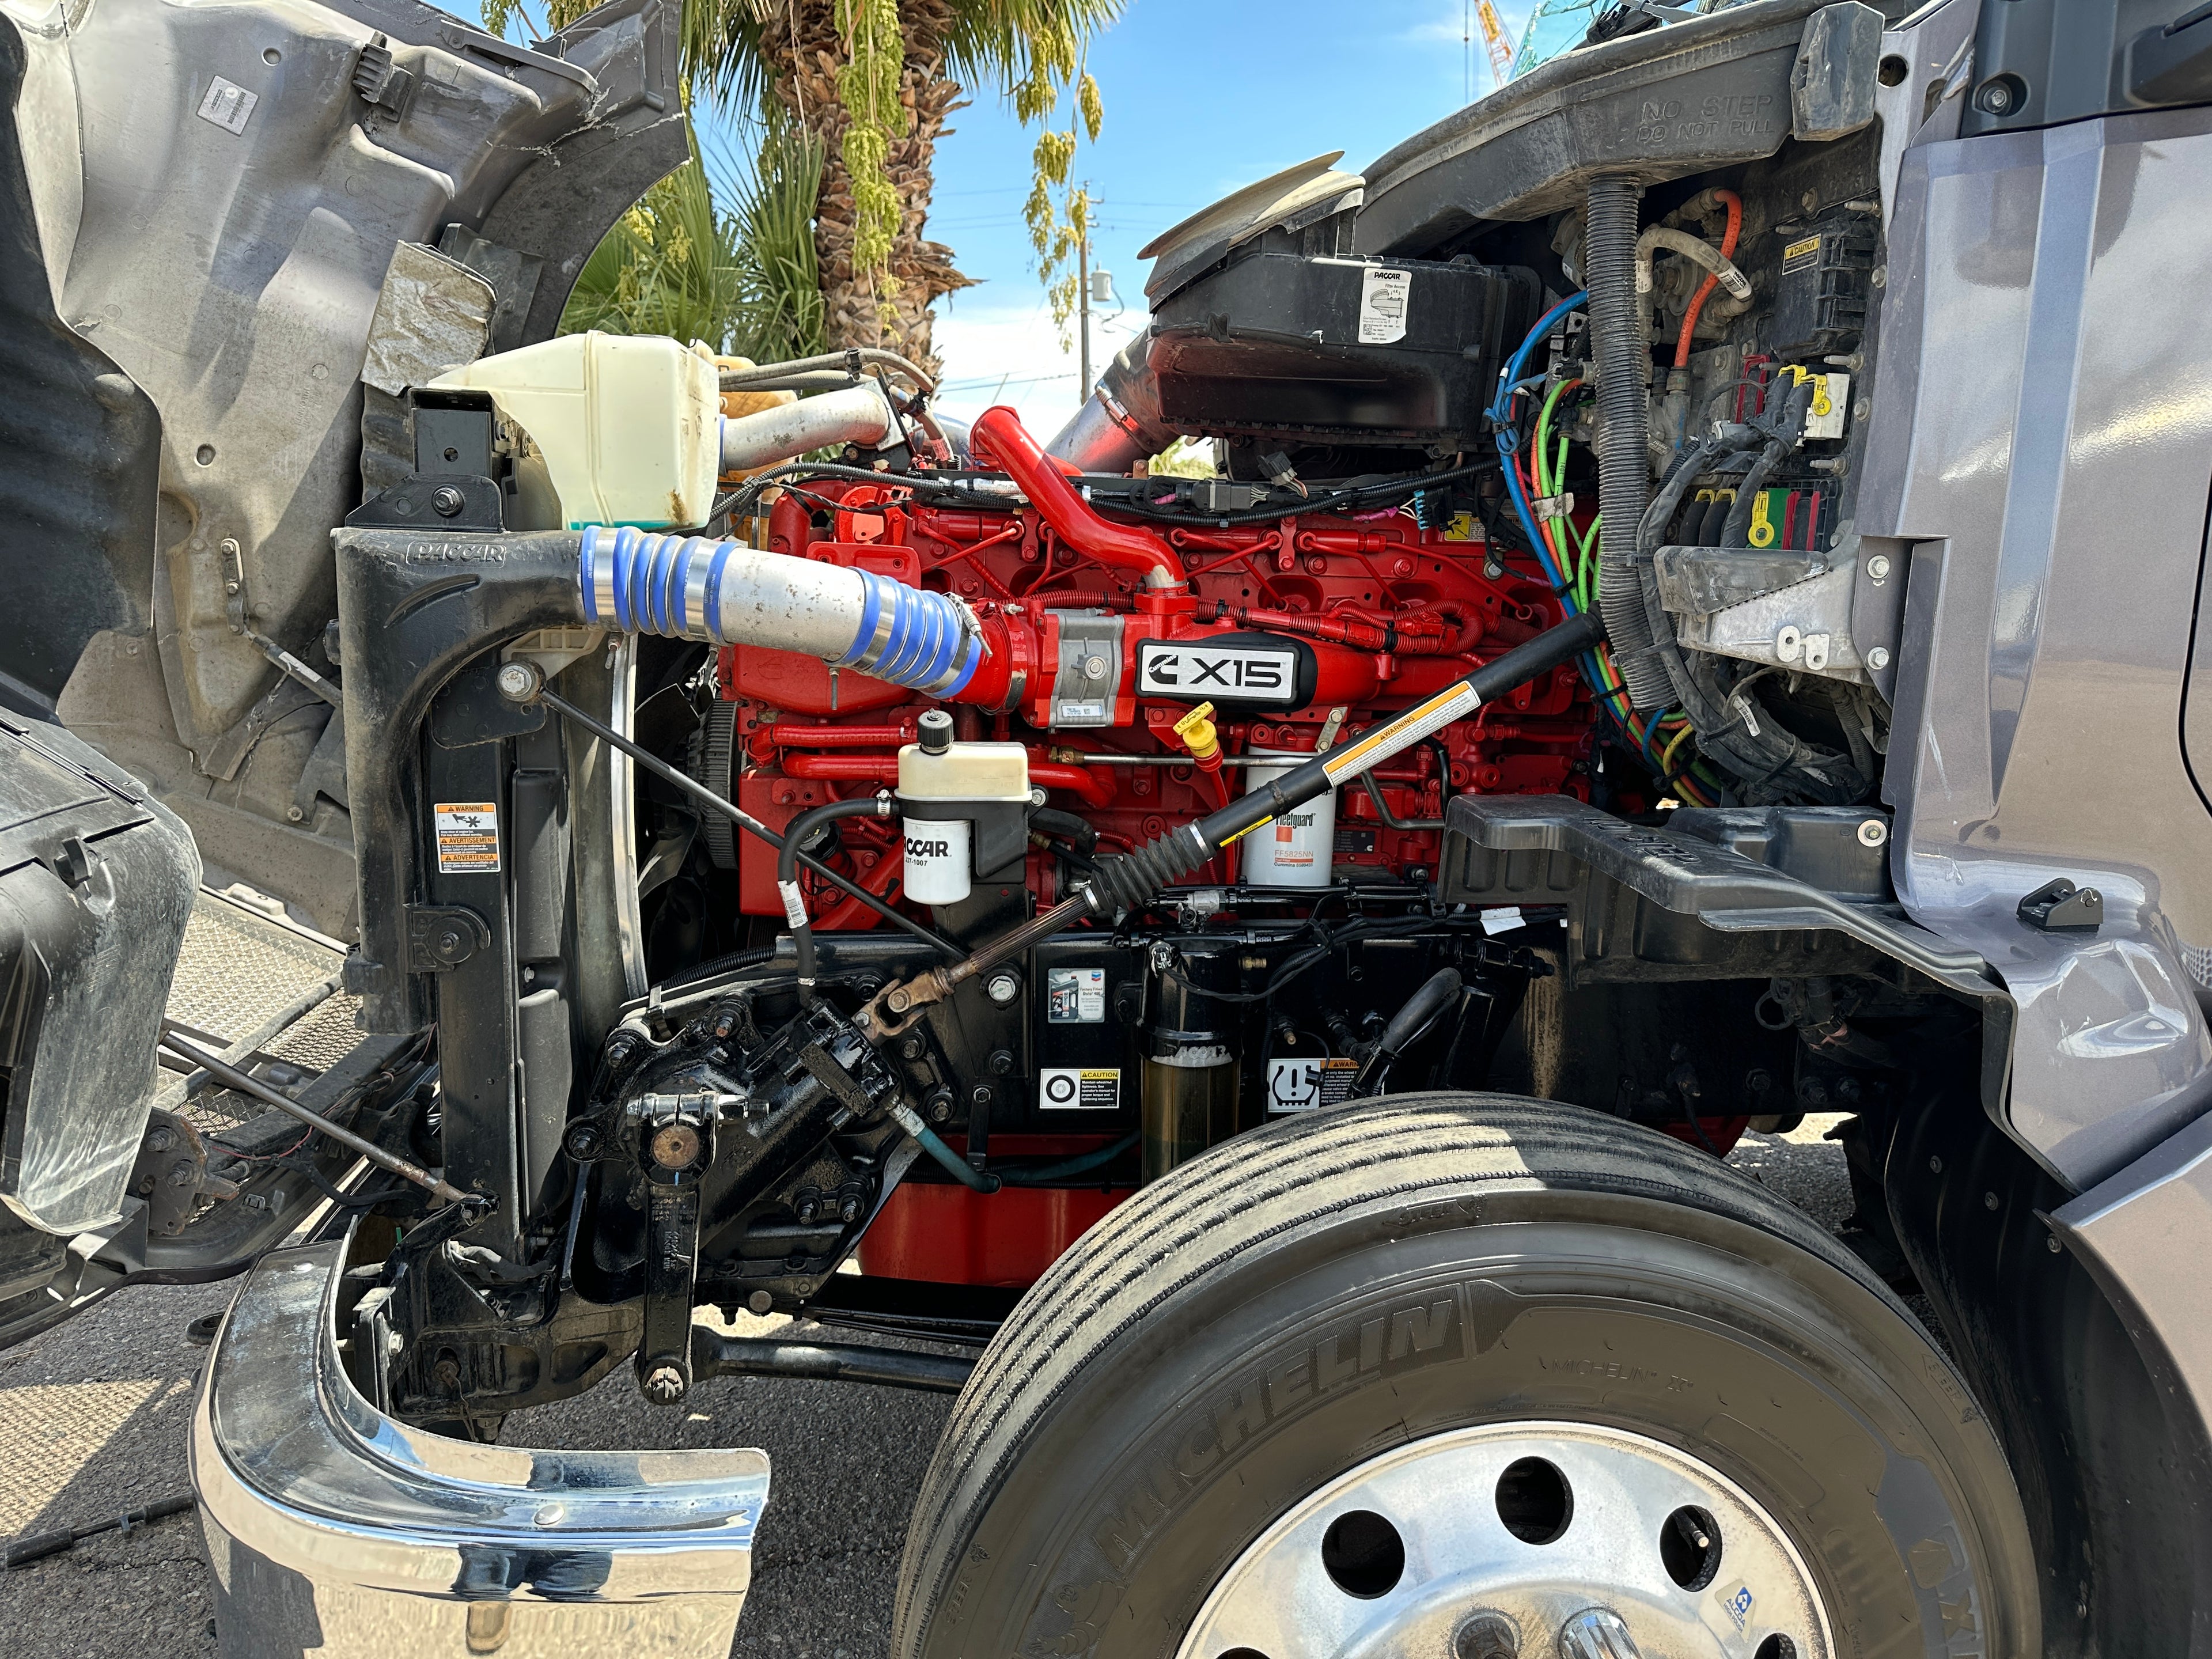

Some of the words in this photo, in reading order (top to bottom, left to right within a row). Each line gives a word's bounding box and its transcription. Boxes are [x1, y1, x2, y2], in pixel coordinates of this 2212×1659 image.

[1642, 100, 1681, 123] NO
[1701, 94, 1772, 116] STEP
[1637, 126, 1666, 143] DO
[1677, 120, 1718, 140] NOT
[1730, 119, 1775, 136] PULL
[1794, 241, 1815, 254] CAUTION
[1374, 272, 1400, 280] PACCAR
[413, 543, 503, 563] PACCAR
[1148, 654, 1177, 673] Cummins
[1188, 658, 1282, 688] X15
[1384, 715, 1415, 737] WARNING
[904, 836, 949, 857] CCAR
[1275, 850, 1313, 858] FF5825NN
[1552, 1358, 1649, 1383] MICHELIN
[1666, 1375, 1688, 1392] X
[1926, 1363, 1964, 1400] STEER
[1092, 1298, 1453, 1574] MICHELIN
[1726, 1599, 1745, 1628] ALCOA
